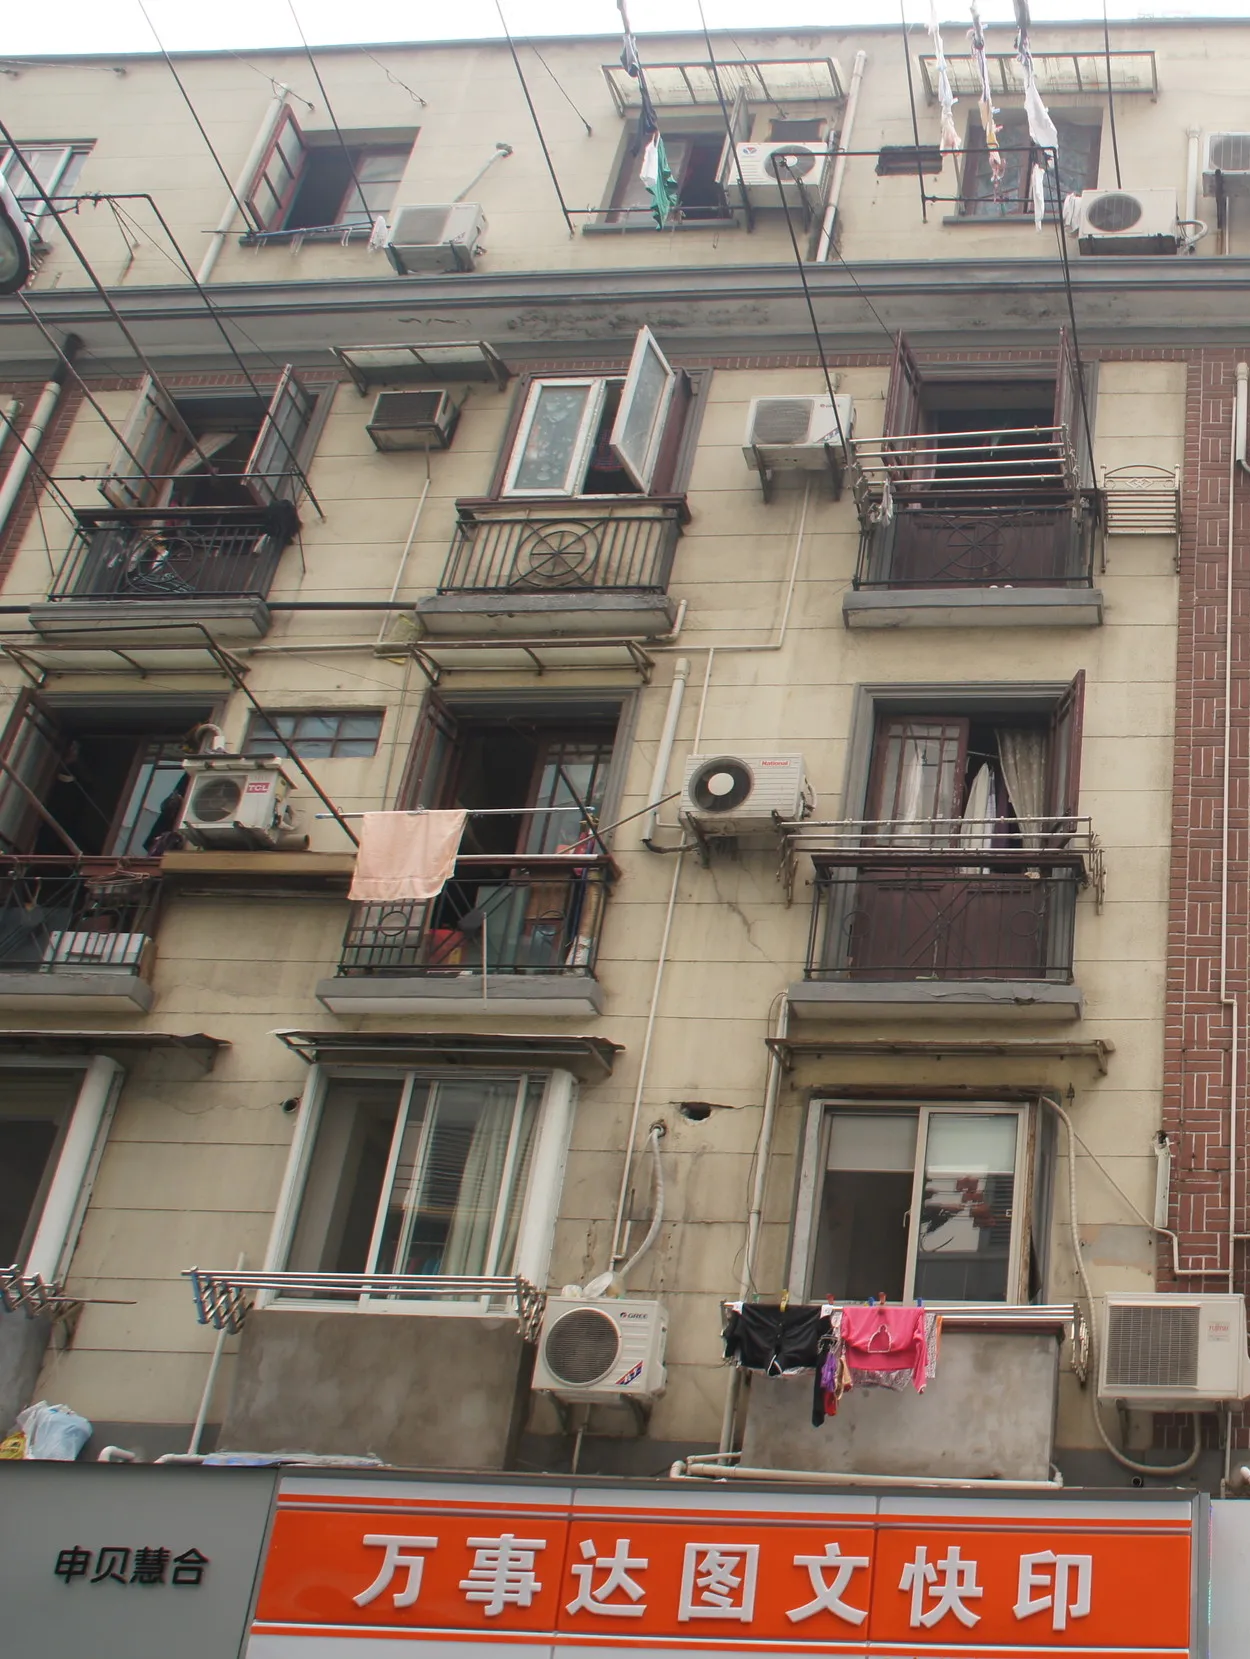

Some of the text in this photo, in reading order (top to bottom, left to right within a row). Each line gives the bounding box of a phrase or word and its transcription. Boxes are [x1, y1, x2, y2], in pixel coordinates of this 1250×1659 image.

[248, 784, 269, 792] TCL
[54, 1545, 210, 1586] 申贝慧合
[352, 1533, 1093, 1631] 万事达图文快印
